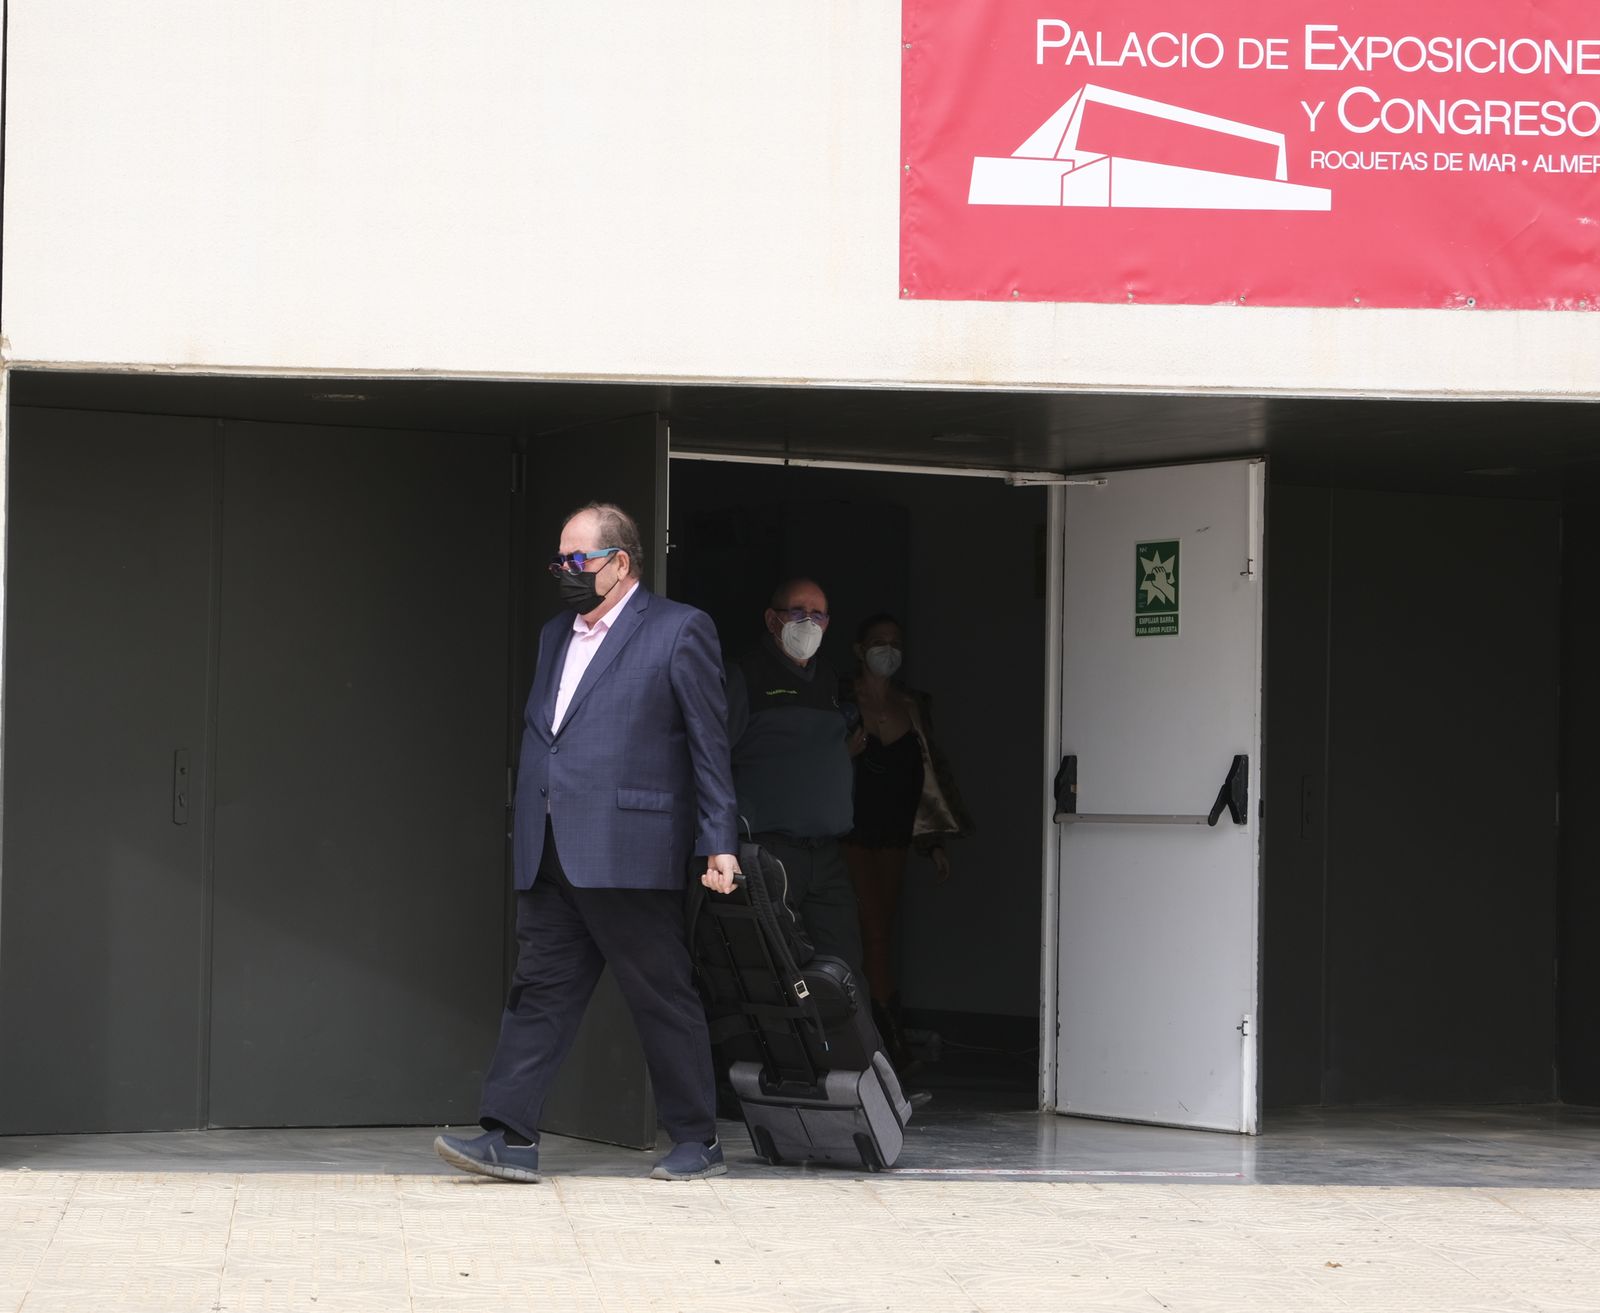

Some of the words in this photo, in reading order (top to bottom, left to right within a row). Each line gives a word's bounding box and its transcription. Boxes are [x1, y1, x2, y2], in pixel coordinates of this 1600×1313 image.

[1036, 18, 1225, 69] PALACIO
[1238, 37, 1289, 70] DE
[1300, 100, 1325, 132] Y
[1337, 85, 1600, 137] CONGRESO
[1310, 150, 1428, 172] ROQUETAS
[1433, 152, 1463, 172] DE
[1469, 152, 1516, 172] MAR
